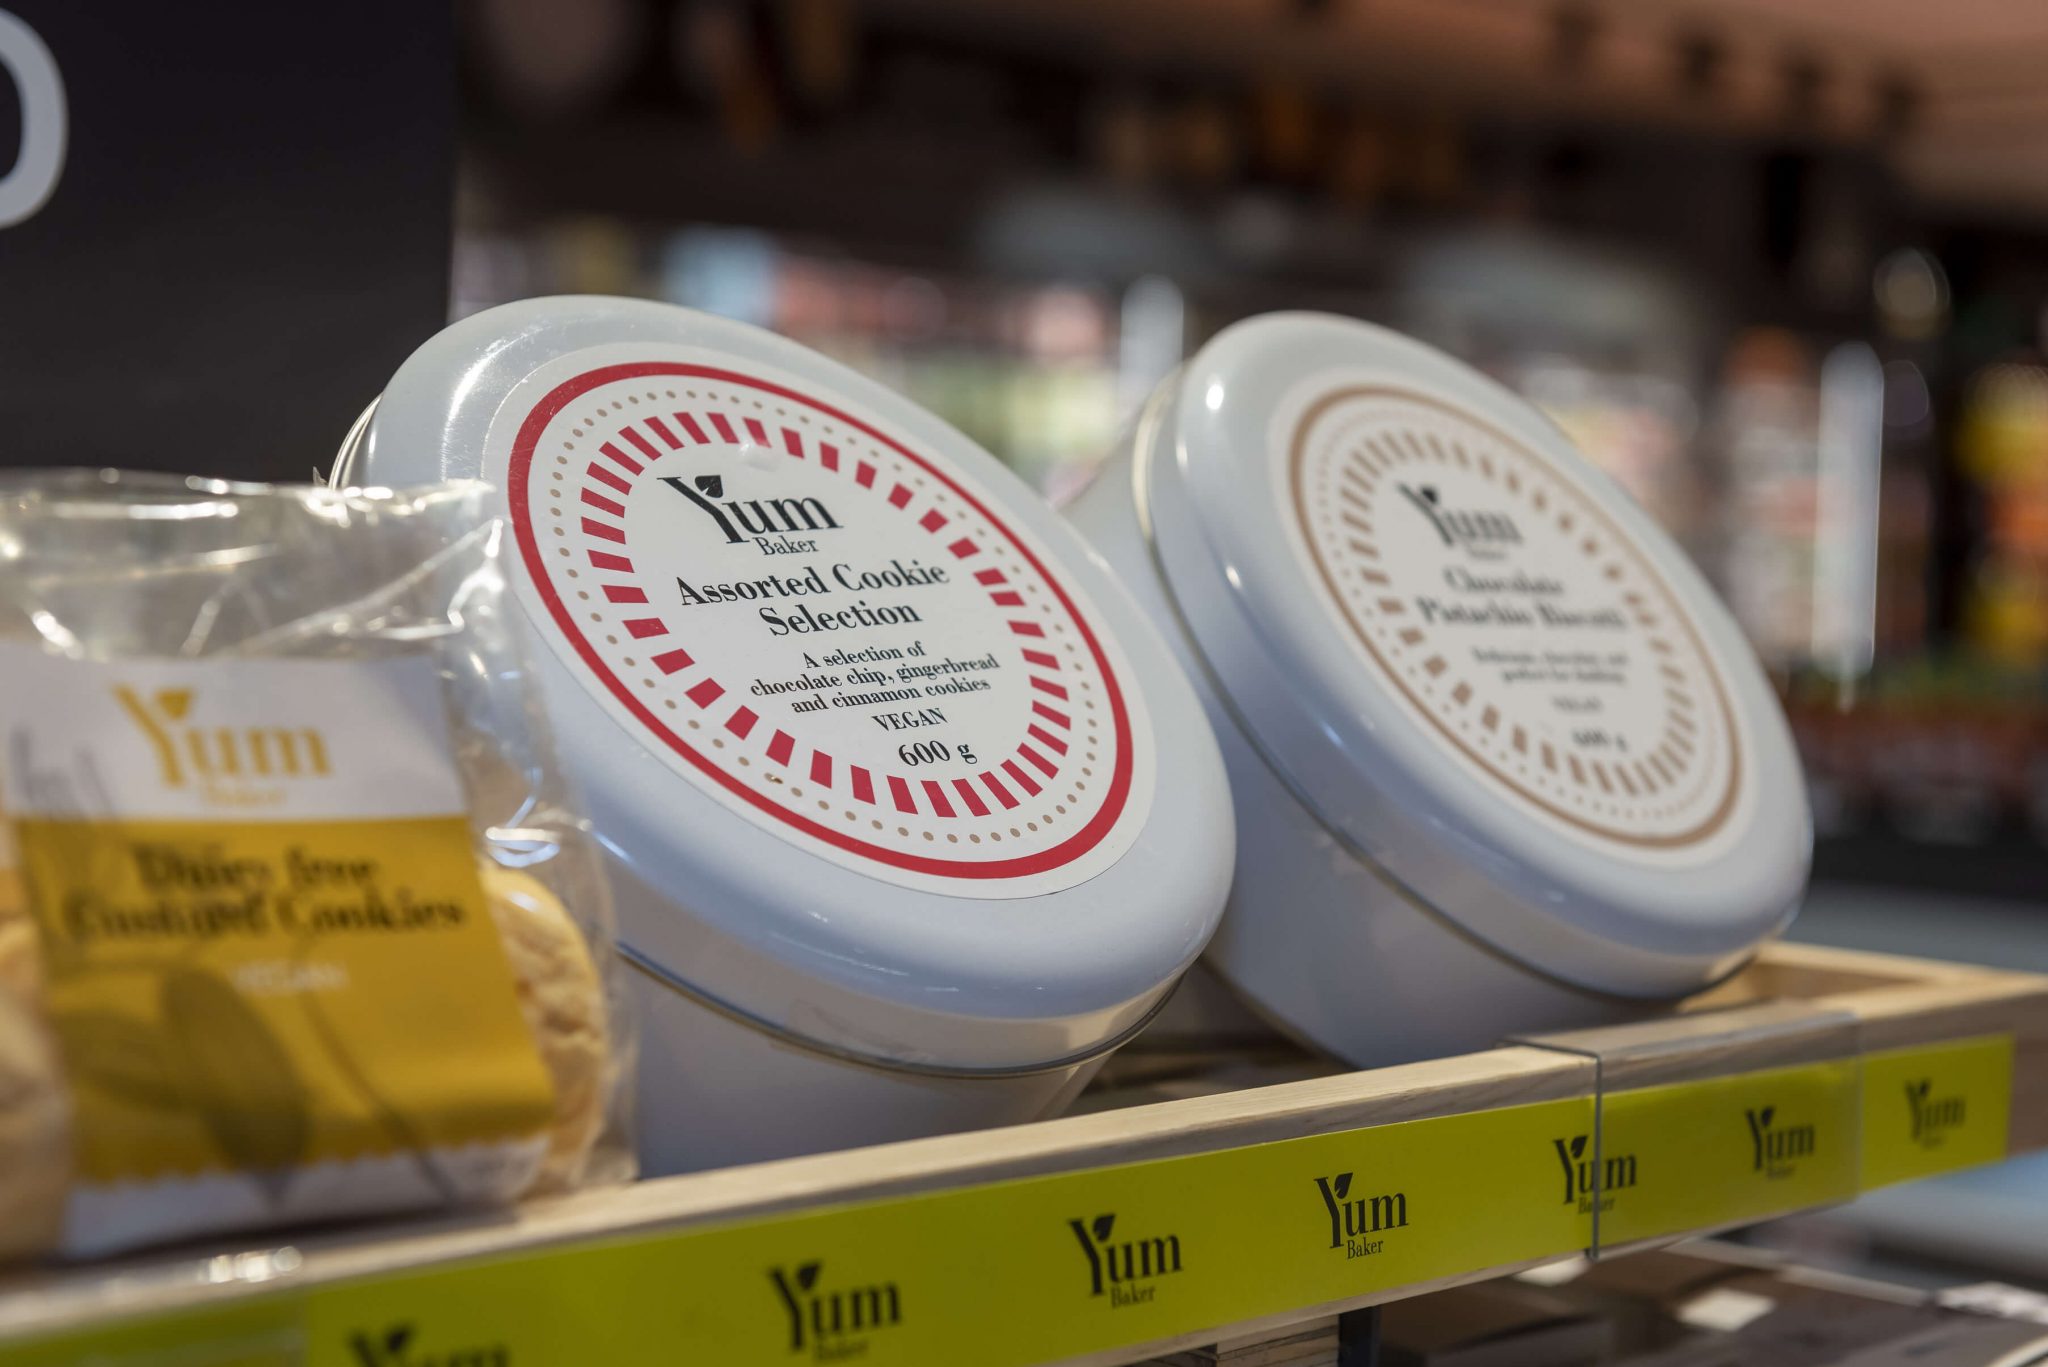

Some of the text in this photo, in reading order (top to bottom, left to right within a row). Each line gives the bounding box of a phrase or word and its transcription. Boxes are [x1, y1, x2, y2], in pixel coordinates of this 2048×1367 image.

[656, 474, 844, 544] Yum
[752, 535, 820, 556] Baker
[676, 559, 951, 606] Assorted Cookie
[759, 600, 923, 637] Selection
[750, 653, 1001, 697] chocolate chip, gingerbread
[803, 640, 928, 669] A selection of
[791, 676, 991, 714] and cinnamon cookies
[112, 683, 332, 788] Yum
[871, 708, 949, 732] VEGAN
[898, 740, 979, 767] 600 g
[1745, 1106, 1816, 1172] Yum
[1553, 1134, 1638, 1205] Yum
[1314, 1171, 1410, 1249] Yum
[1066, 1213, 1184, 1298] Yum
[1346, 1236, 1385, 1260] Baker
[766, 1259, 902, 1352] Yum
[1110, 1284, 1157, 1310] Baker
